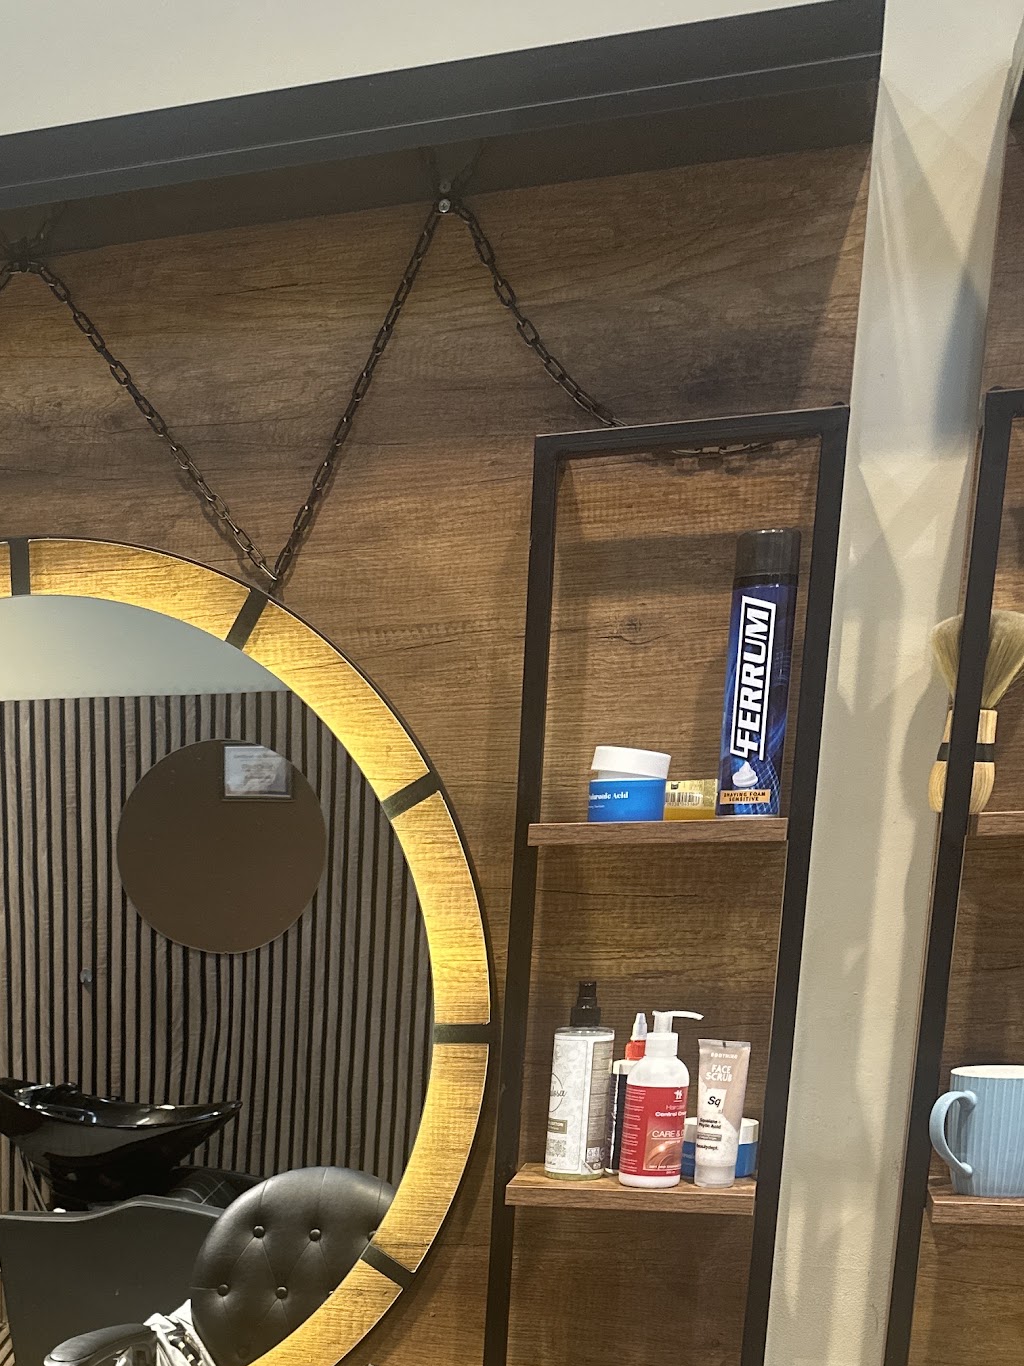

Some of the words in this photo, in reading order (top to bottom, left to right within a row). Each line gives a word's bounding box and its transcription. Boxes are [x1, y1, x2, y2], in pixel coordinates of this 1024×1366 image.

[733, 606, 770, 760] FERRUM
[613, 791, 629, 799] Acid
[711, 1064, 732, 1074] FACE
[705, 1072, 733, 1082] SCRUB
[707, 1096, 722, 1107] Sq
[652, 1130, 676, 1138] CARE
